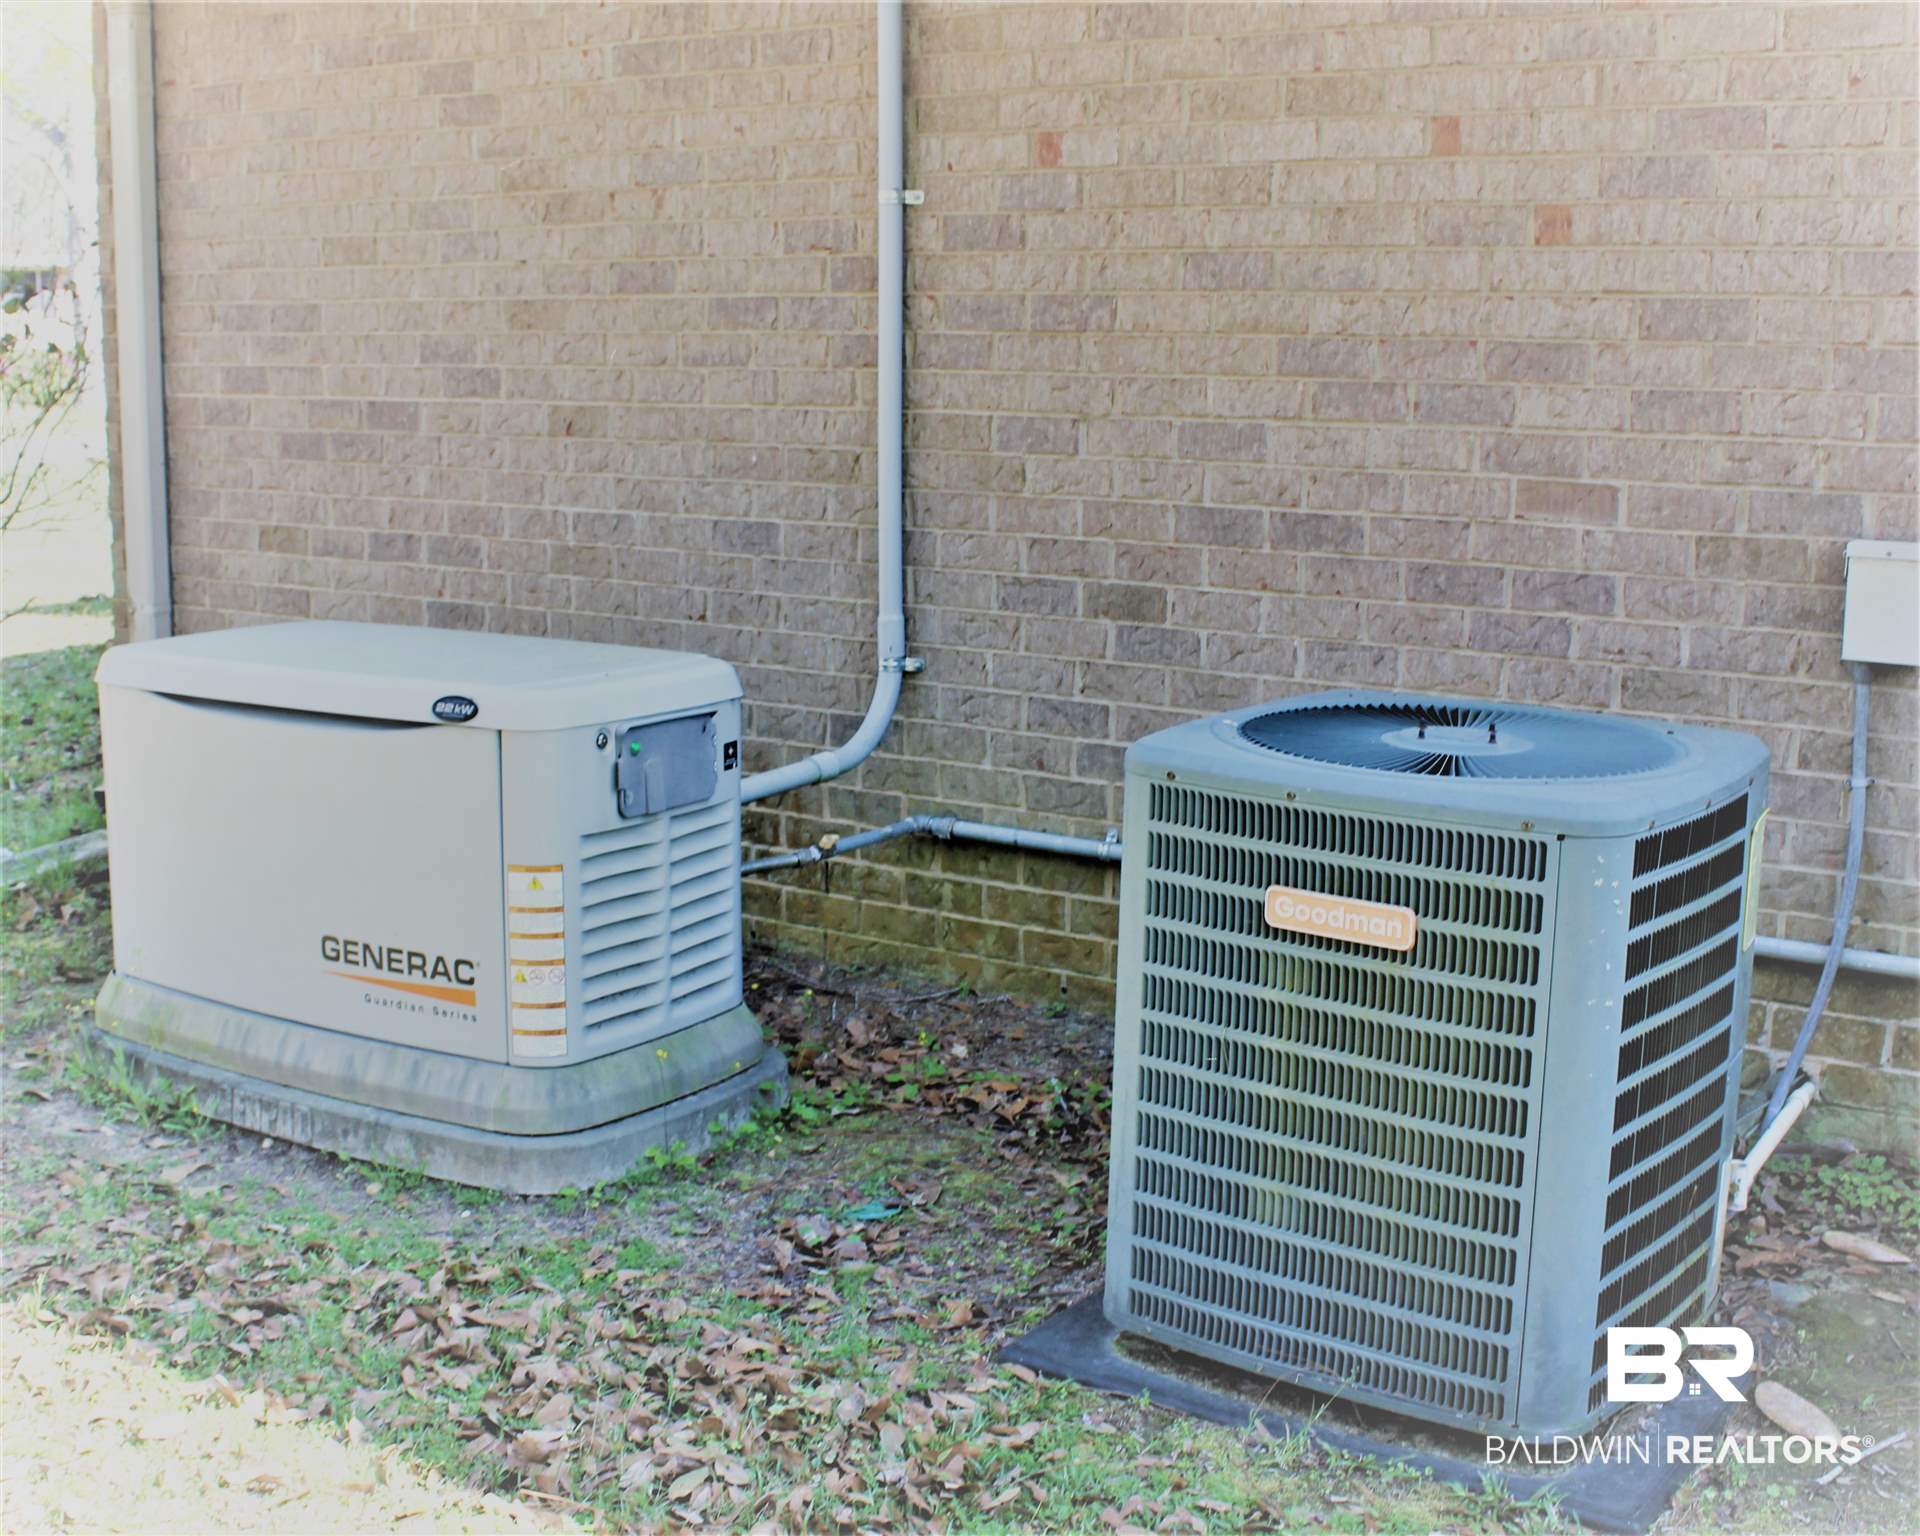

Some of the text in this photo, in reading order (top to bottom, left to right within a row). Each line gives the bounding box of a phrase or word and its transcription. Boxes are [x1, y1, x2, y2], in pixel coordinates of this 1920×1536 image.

[1274, 895, 1403, 939] Goodman
[321, 935, 475, 986] GENERAC
[364, 993, 478, 1023] Guardian Series
